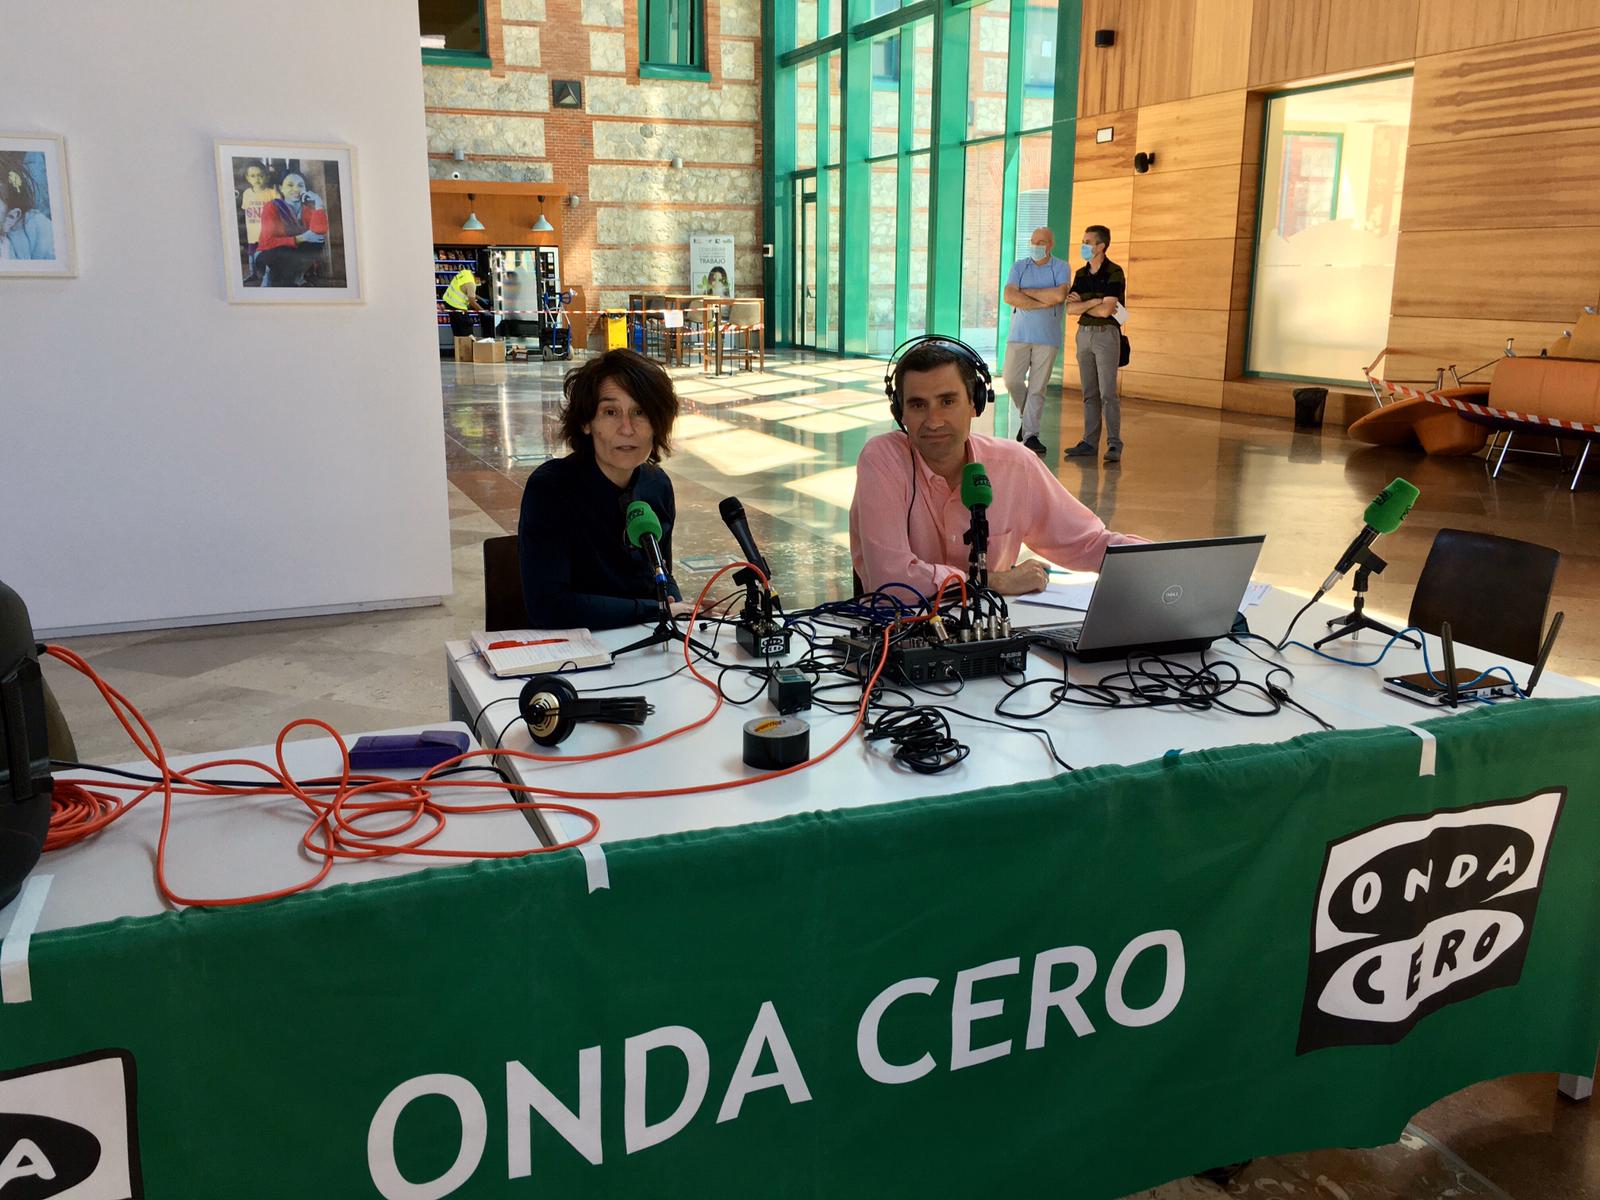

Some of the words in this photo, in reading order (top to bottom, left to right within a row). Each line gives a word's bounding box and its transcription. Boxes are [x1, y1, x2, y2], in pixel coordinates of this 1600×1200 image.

[699, 257, 726, 265] TRABAJO
[1352, 845, 1516, 914] ONDA
[1353, 922, 1501, 1005] CERO
[367, 1000, 813, 1200] ONDA
[856, 929, 1186, 1085] CERO
